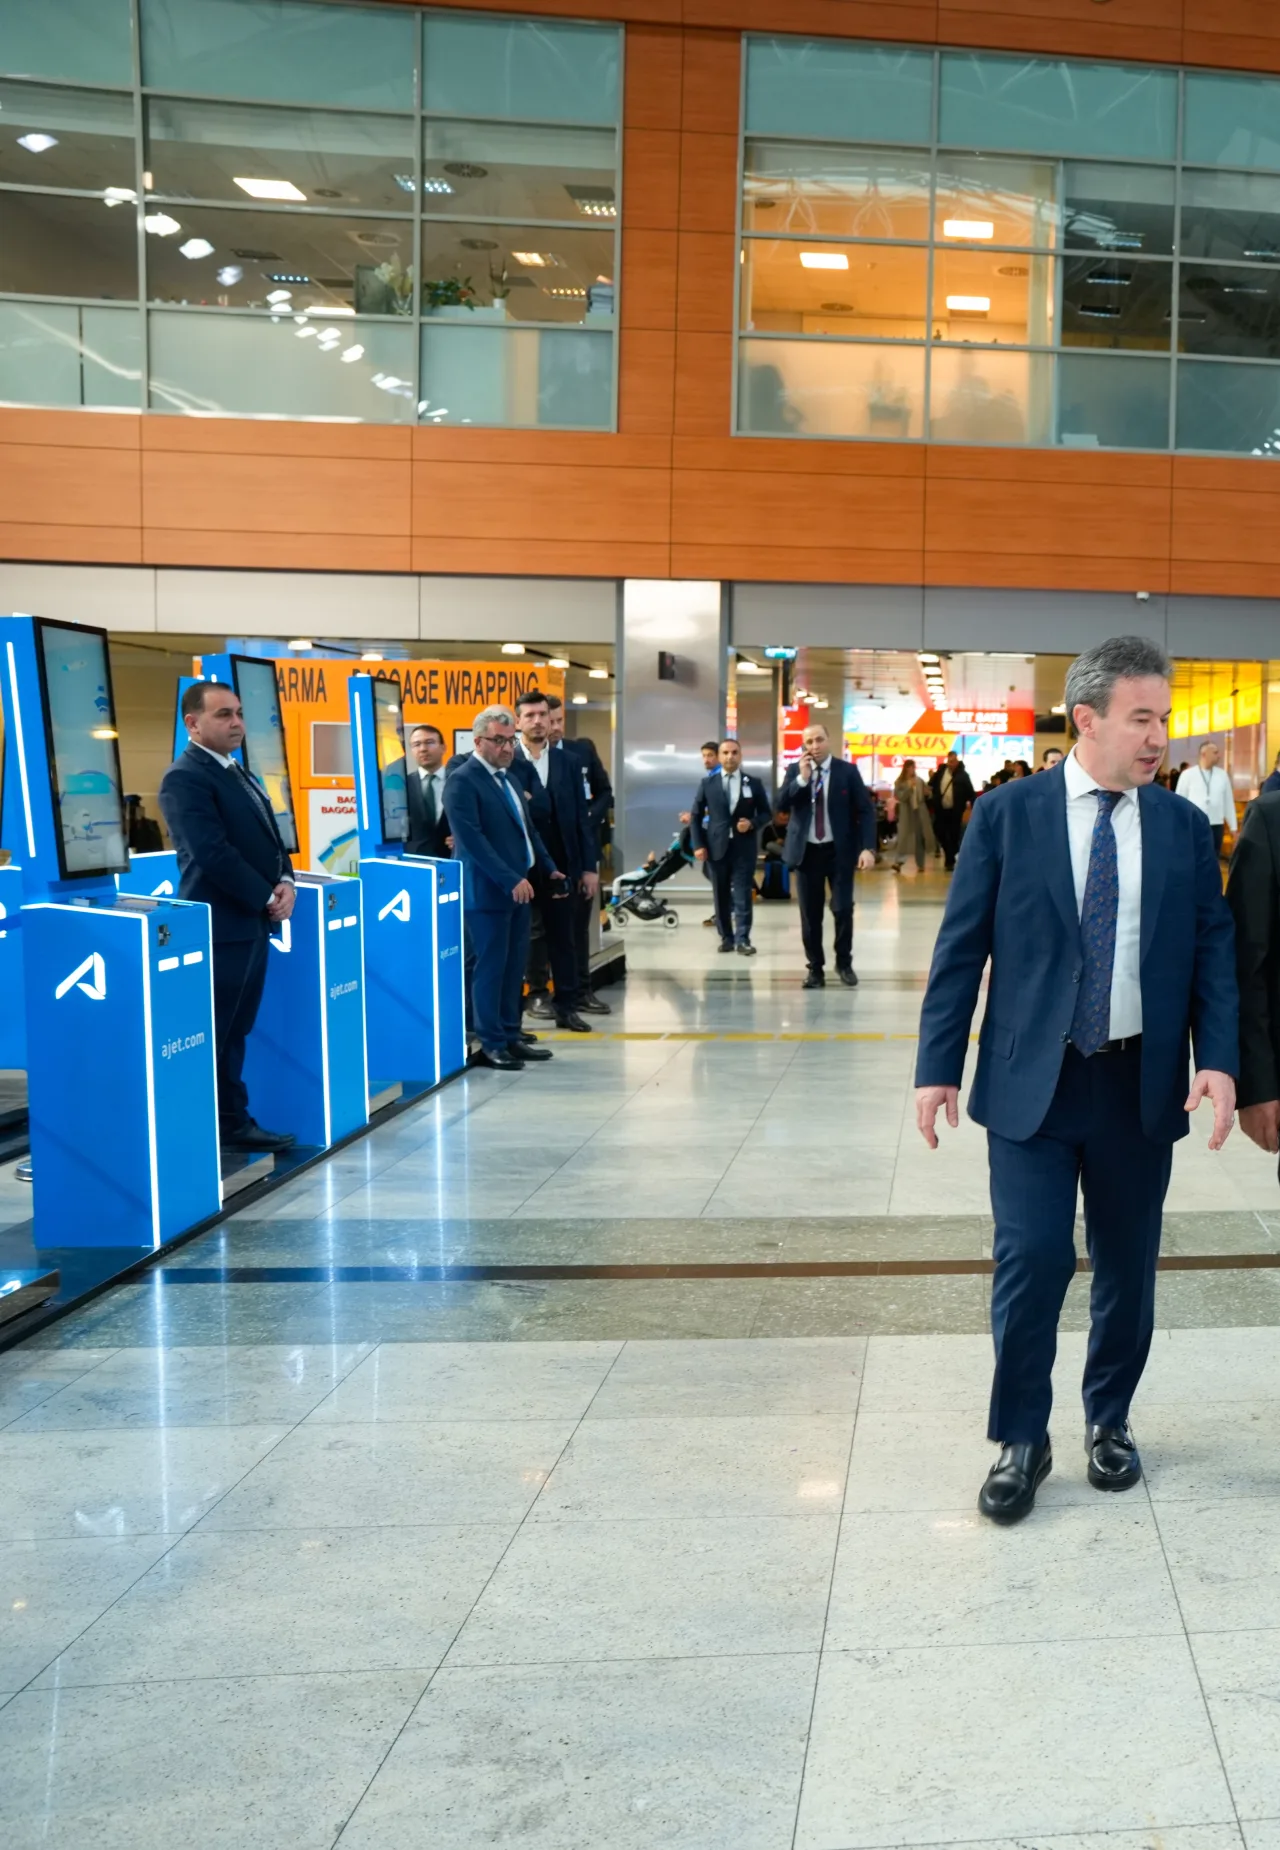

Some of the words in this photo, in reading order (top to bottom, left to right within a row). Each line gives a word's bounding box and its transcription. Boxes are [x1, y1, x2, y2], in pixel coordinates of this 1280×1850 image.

[444, 670, 539, 706] WRAPPING
[861, 734, 947, 750] PEGASUS
[56, 952, 107, 1000] A
[330, 972, 358, 1000] ajet.com
[162, 1031, 205, 1060] ajet.com
